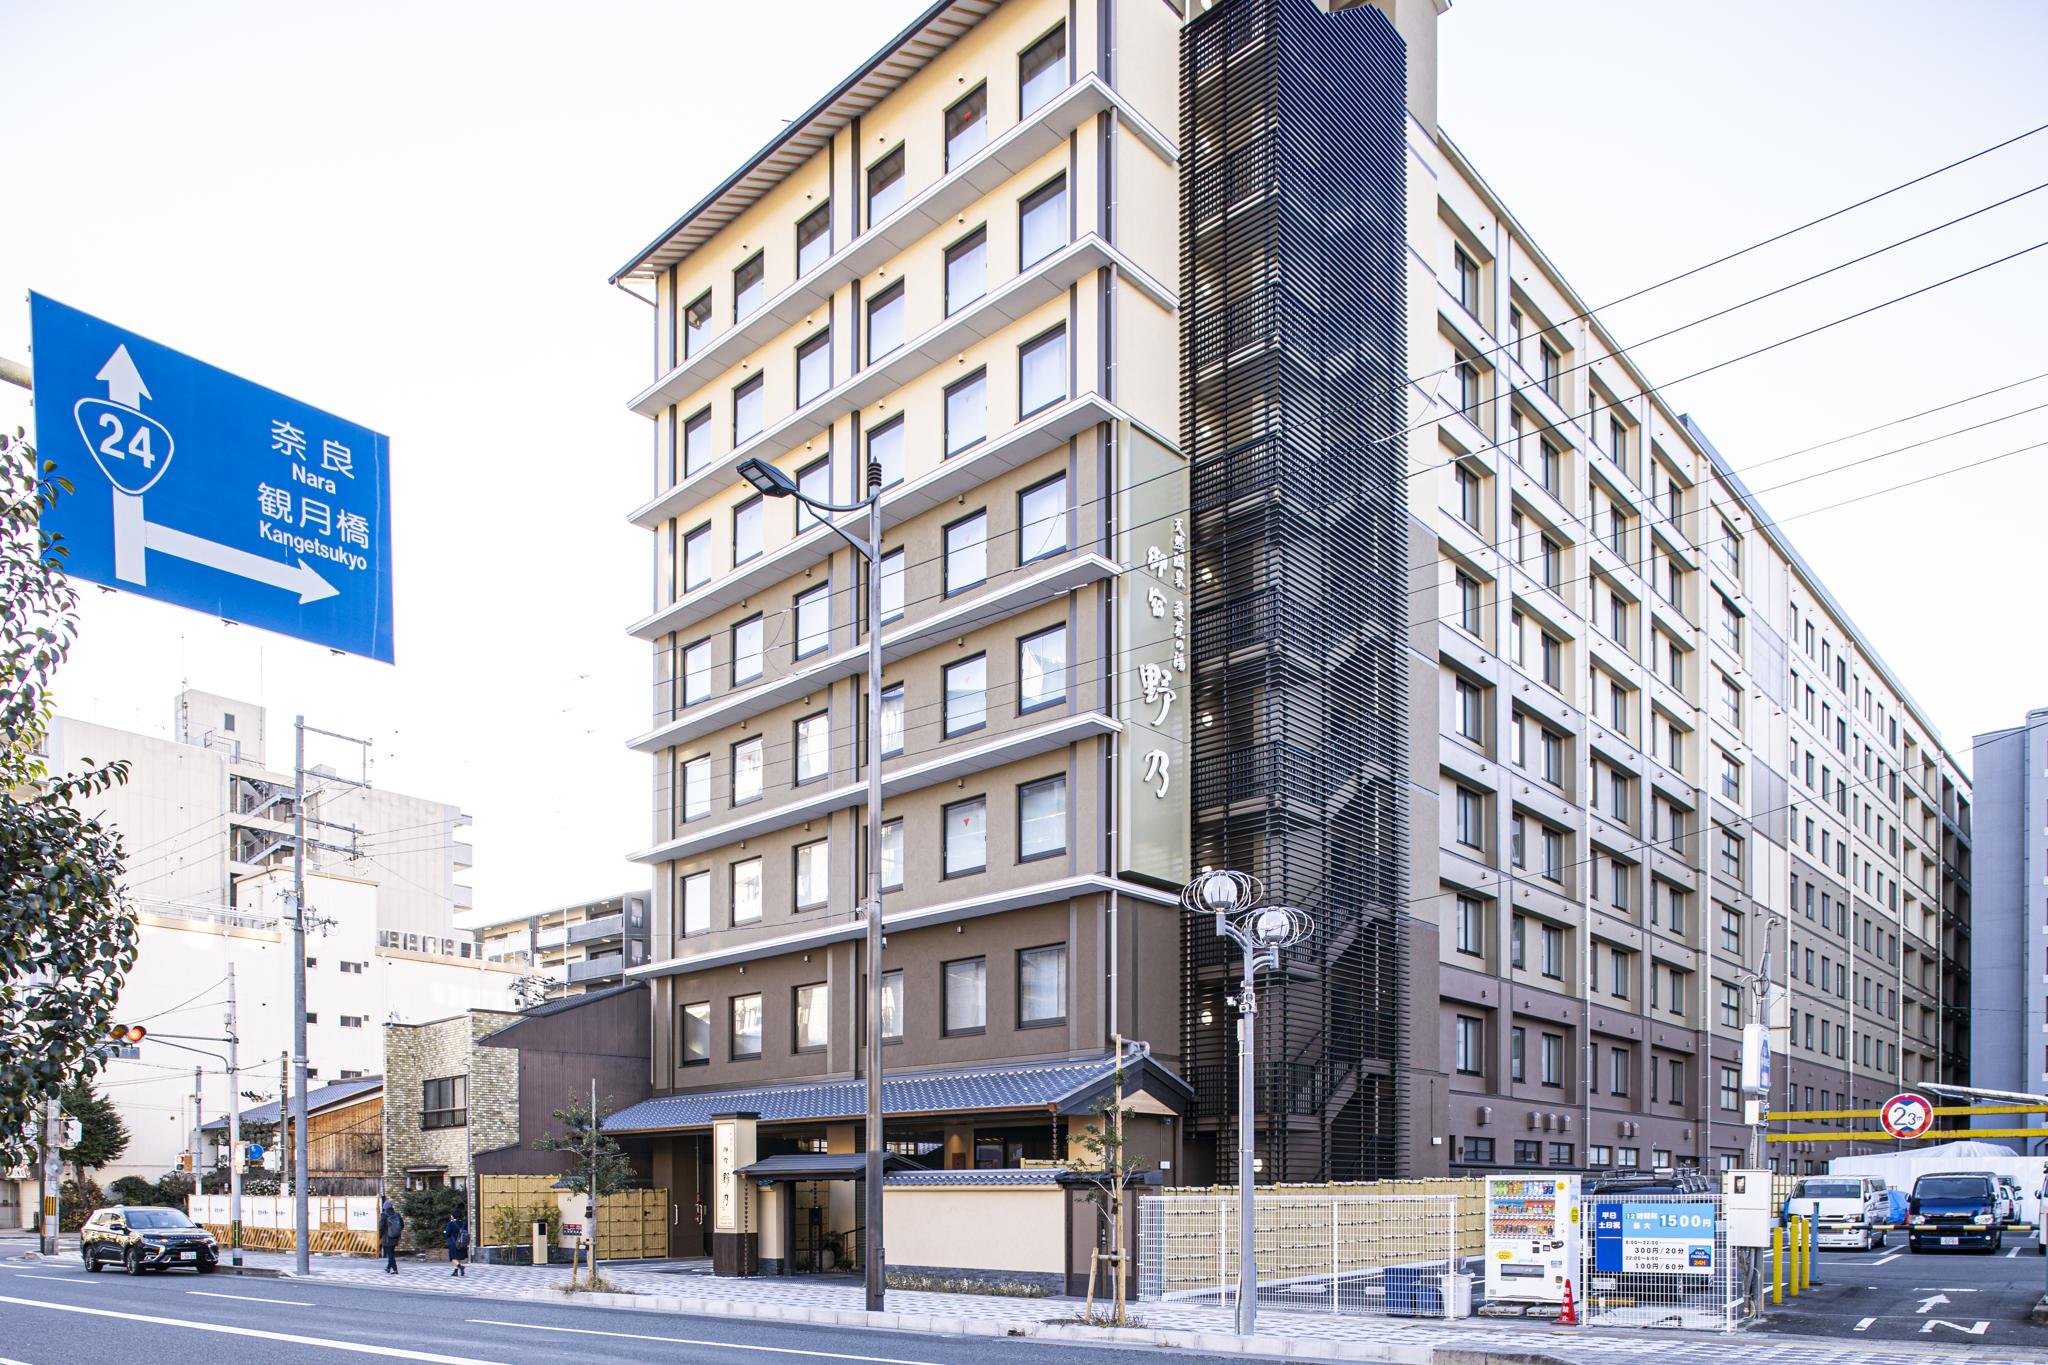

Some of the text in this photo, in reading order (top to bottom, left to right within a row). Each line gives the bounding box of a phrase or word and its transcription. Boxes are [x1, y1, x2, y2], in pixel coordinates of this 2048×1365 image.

[99, 413, 156, 469] 24
[271, 419, 355, 479] 奈良
[291, 461, 337, 495] Nara
[257, 481, 370, 550] 観月橋
[259, 520, 368, 571] Kangetsukyo
[1598, 1221, 1621, 1230] 土日祝
[1601, 1211, 1617, 1220] 平日
[1660, 1214, 1712, 1228] 1500円
